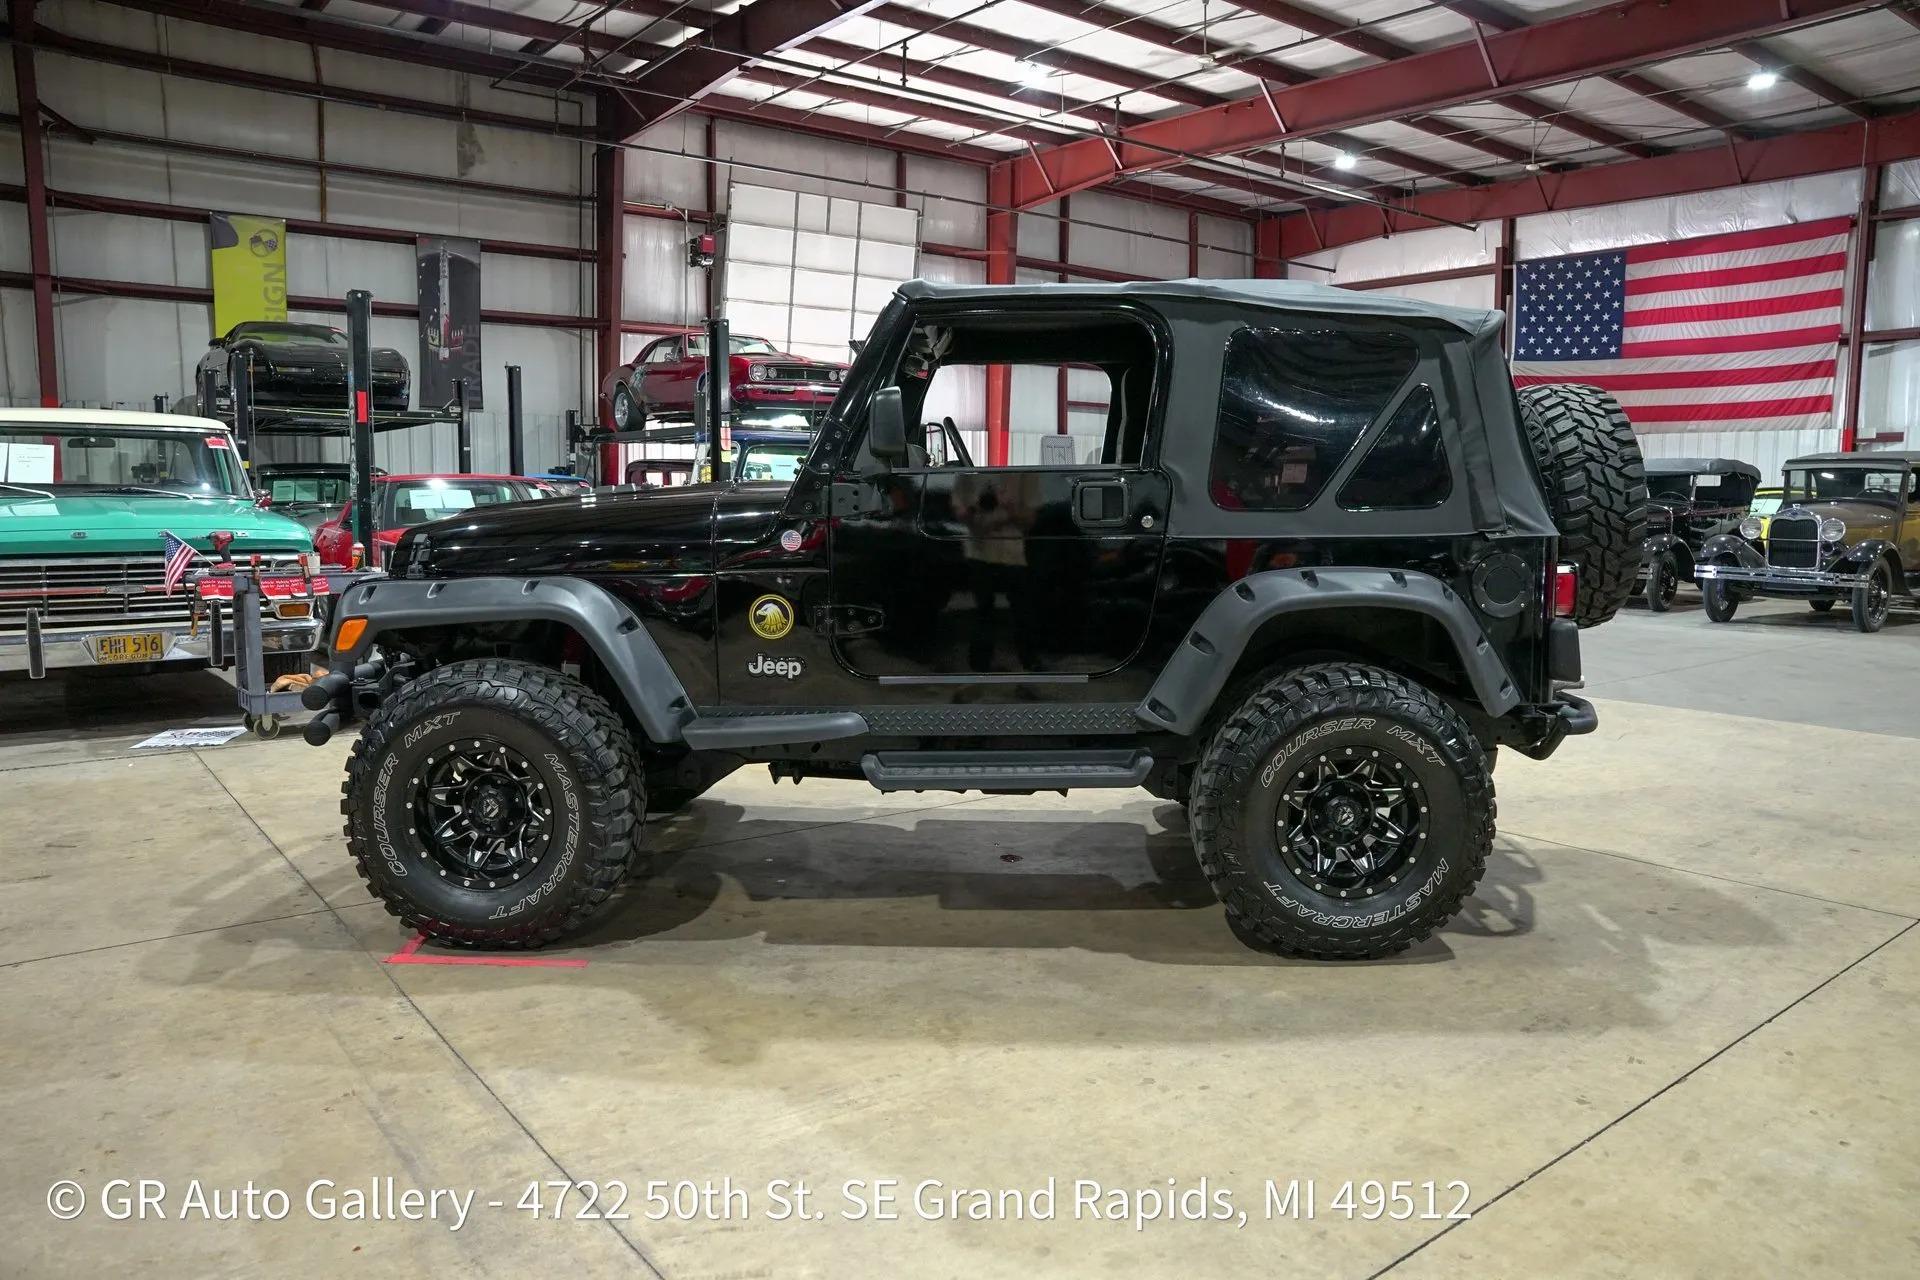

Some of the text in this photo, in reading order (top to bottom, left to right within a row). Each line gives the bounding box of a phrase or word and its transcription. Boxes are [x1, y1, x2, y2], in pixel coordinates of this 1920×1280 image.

[263, 263, 286, 321] IGN
[132, 636, 160, 653] 516
[748, 655, 802, 680] Jeep
[1261, 717, 1446, 788] COURSER MXT
[373, 711, 461, 877] COURSER MXT
[489, 752, 580, 920] MASTERCRAFT
[1263, 857, 1450, 929] MASTERCRAFT
